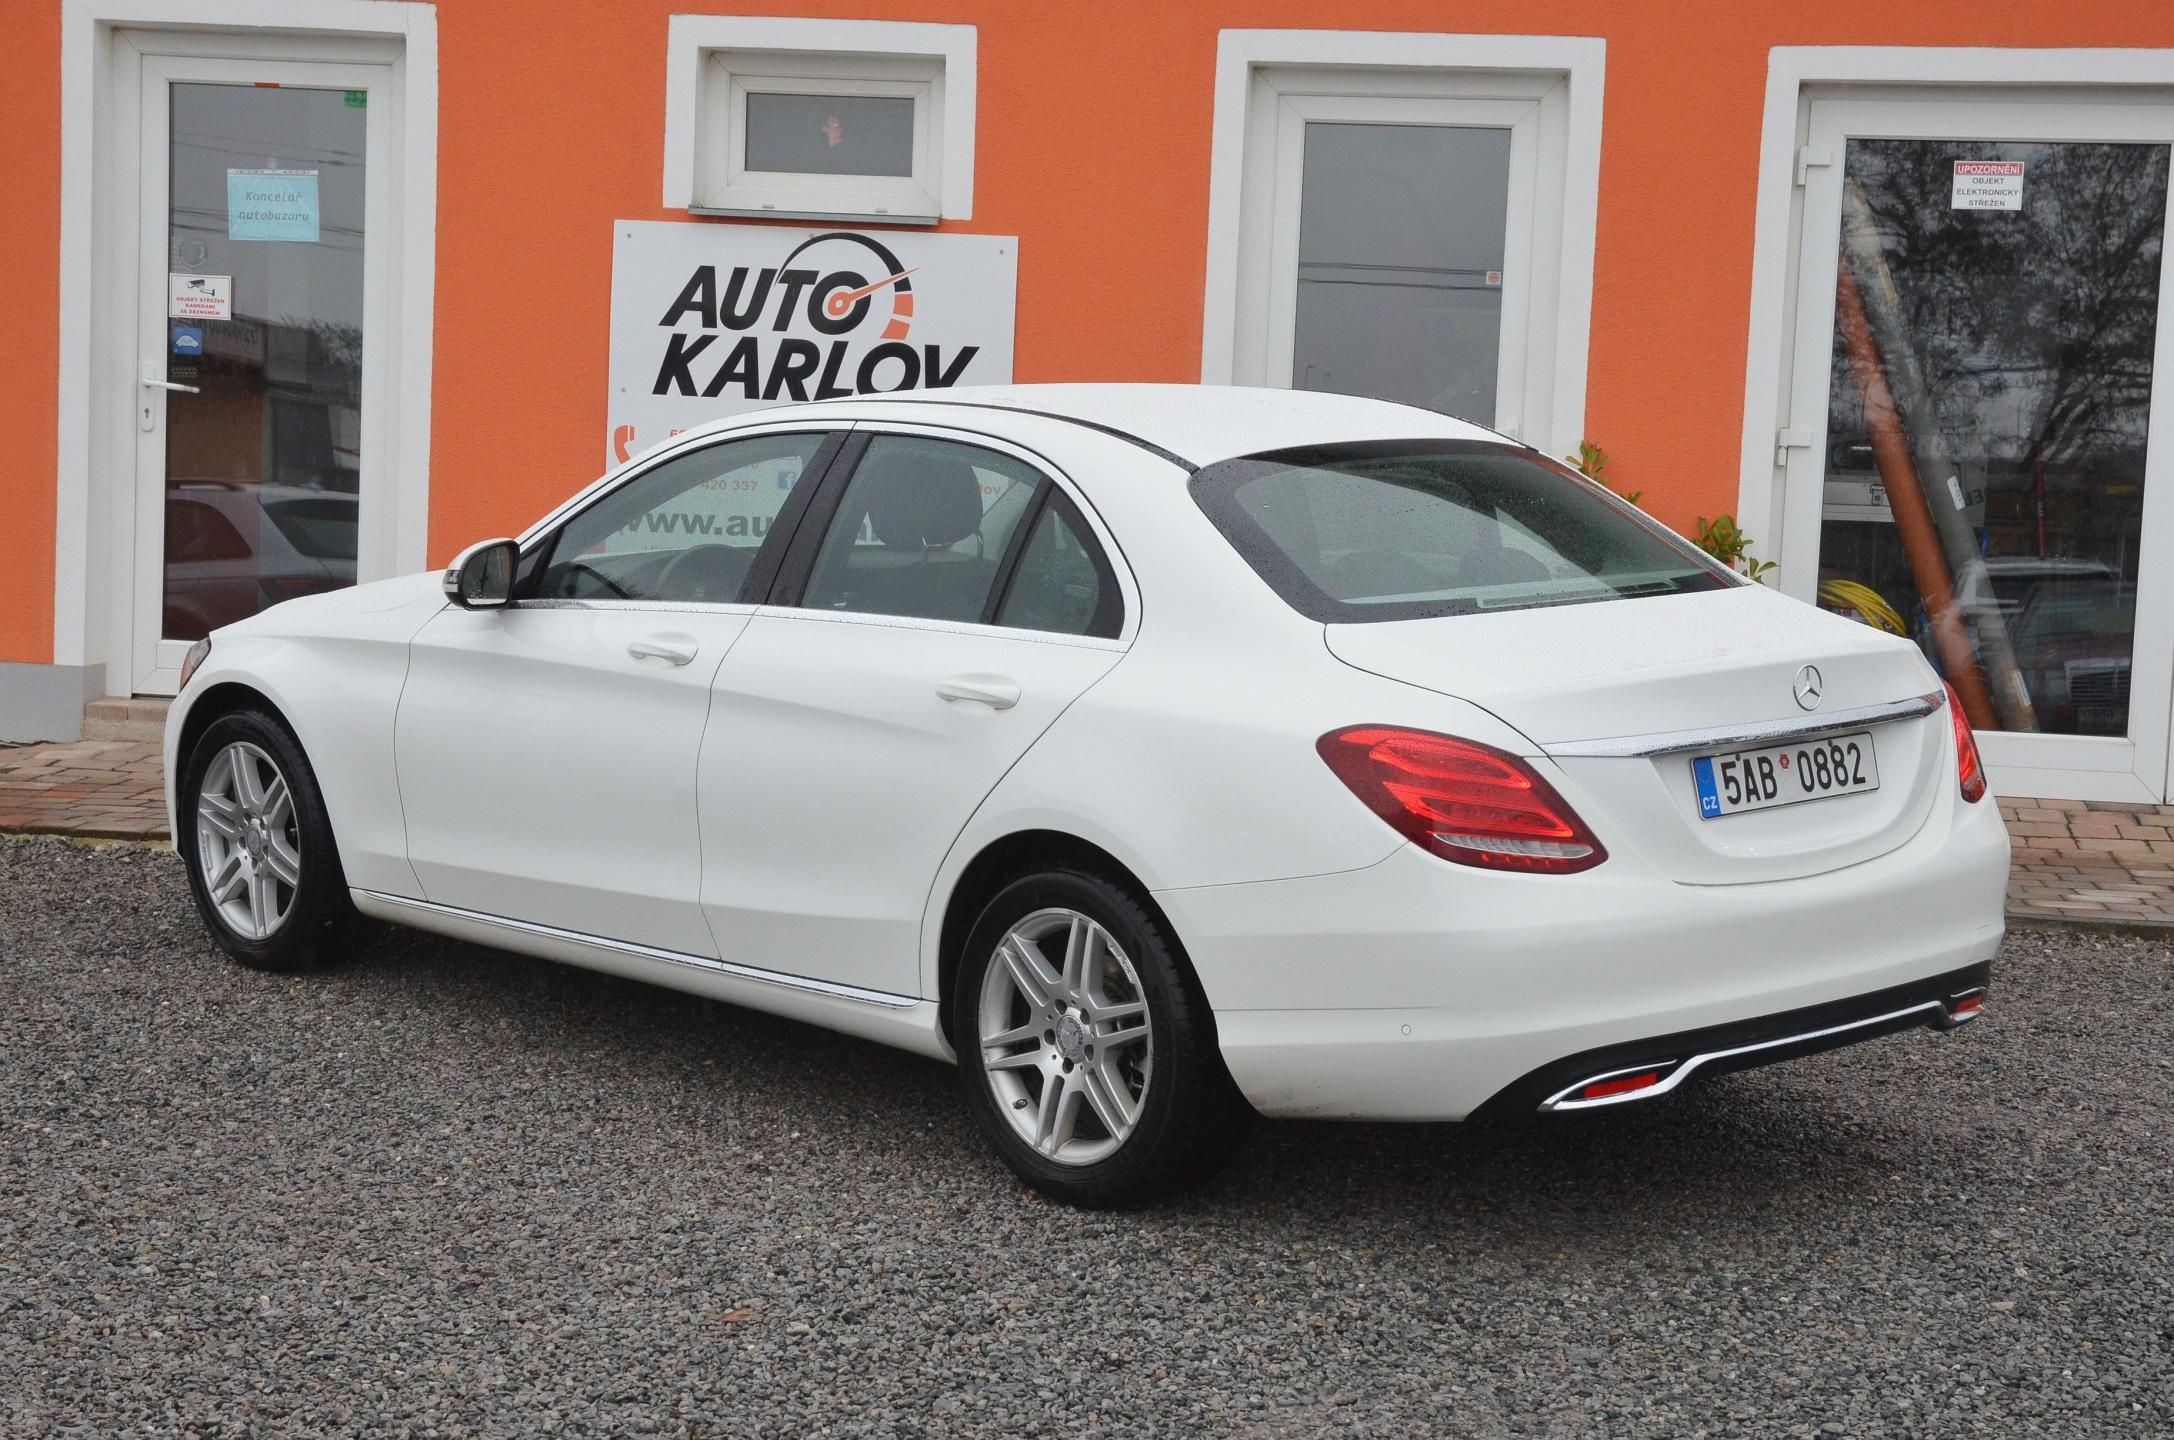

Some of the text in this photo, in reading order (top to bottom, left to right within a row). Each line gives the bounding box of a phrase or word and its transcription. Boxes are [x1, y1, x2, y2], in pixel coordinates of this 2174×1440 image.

[1957, 163, 2021, 175] UPOZORNĚNÍ
[1972, 177, 2005, 185] OBJEKT
[1956, 188, 2018, 196] ELEKTRONICKY
[239, 209, 309, 221] autobazaru
[658, 265, 872, 336] AUTO
[651, 333, 980, 402] KARLOV
[732, 480, 758, 492] 337
[1720, 742, 1866, 805] 5AB 0882
[1702, 795, 1718, 810] CZ
